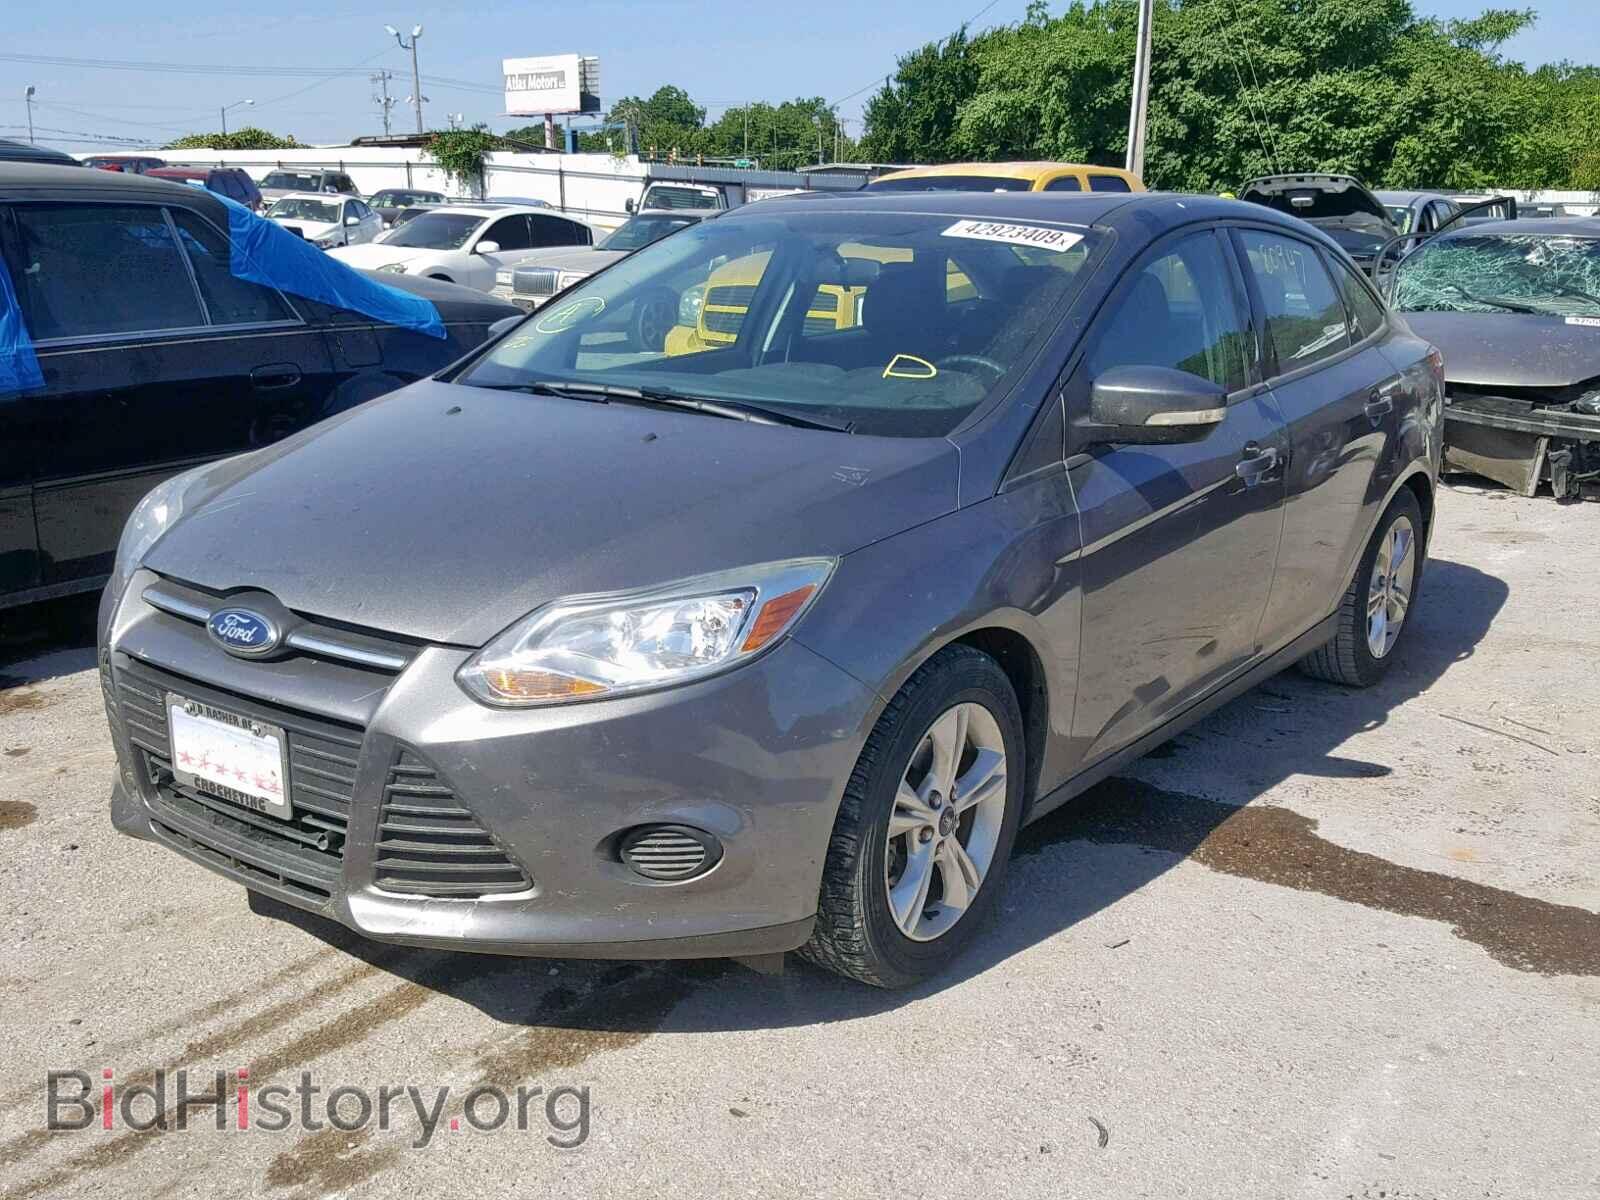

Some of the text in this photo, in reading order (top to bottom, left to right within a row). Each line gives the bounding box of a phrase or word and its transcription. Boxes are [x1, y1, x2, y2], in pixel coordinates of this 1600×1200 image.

[528, 74, 558, 90] Motors
[217, 613, 259, 643] Ford
[193, 776, 267, 811] CROCHETING
